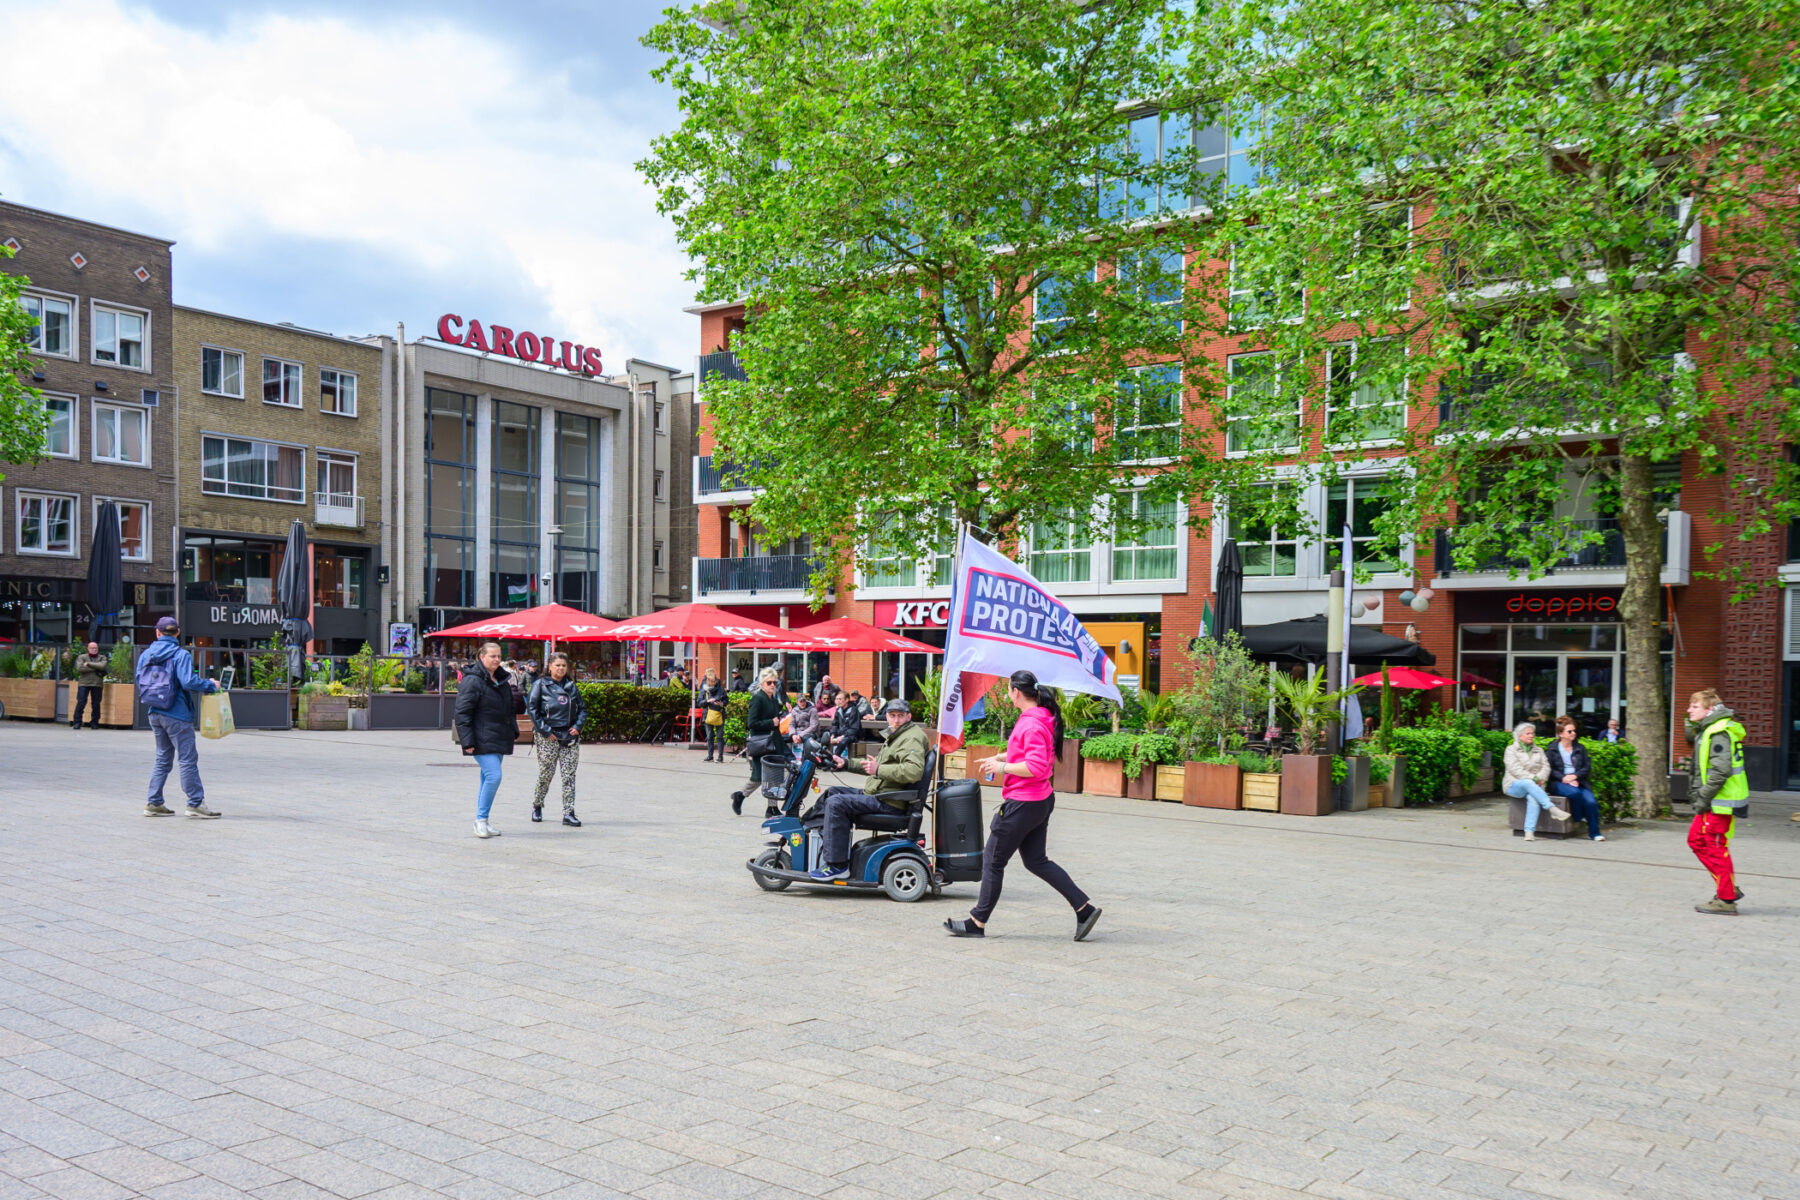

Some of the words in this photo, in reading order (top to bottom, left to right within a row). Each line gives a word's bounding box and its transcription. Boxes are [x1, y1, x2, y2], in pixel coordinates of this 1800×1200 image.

[438, 314, 603, 376] CAROLUS
[1506, 592, 1616, 617] doppio
[76, 614, 90, 624] 24
[211, 606, 228, 623] DE
[893, 601, 949, 626] KFC
[467, 623, 526, 633] KFC
[604, 624, 665, 634] KFC
[713, 626, 777, 638] KFC
